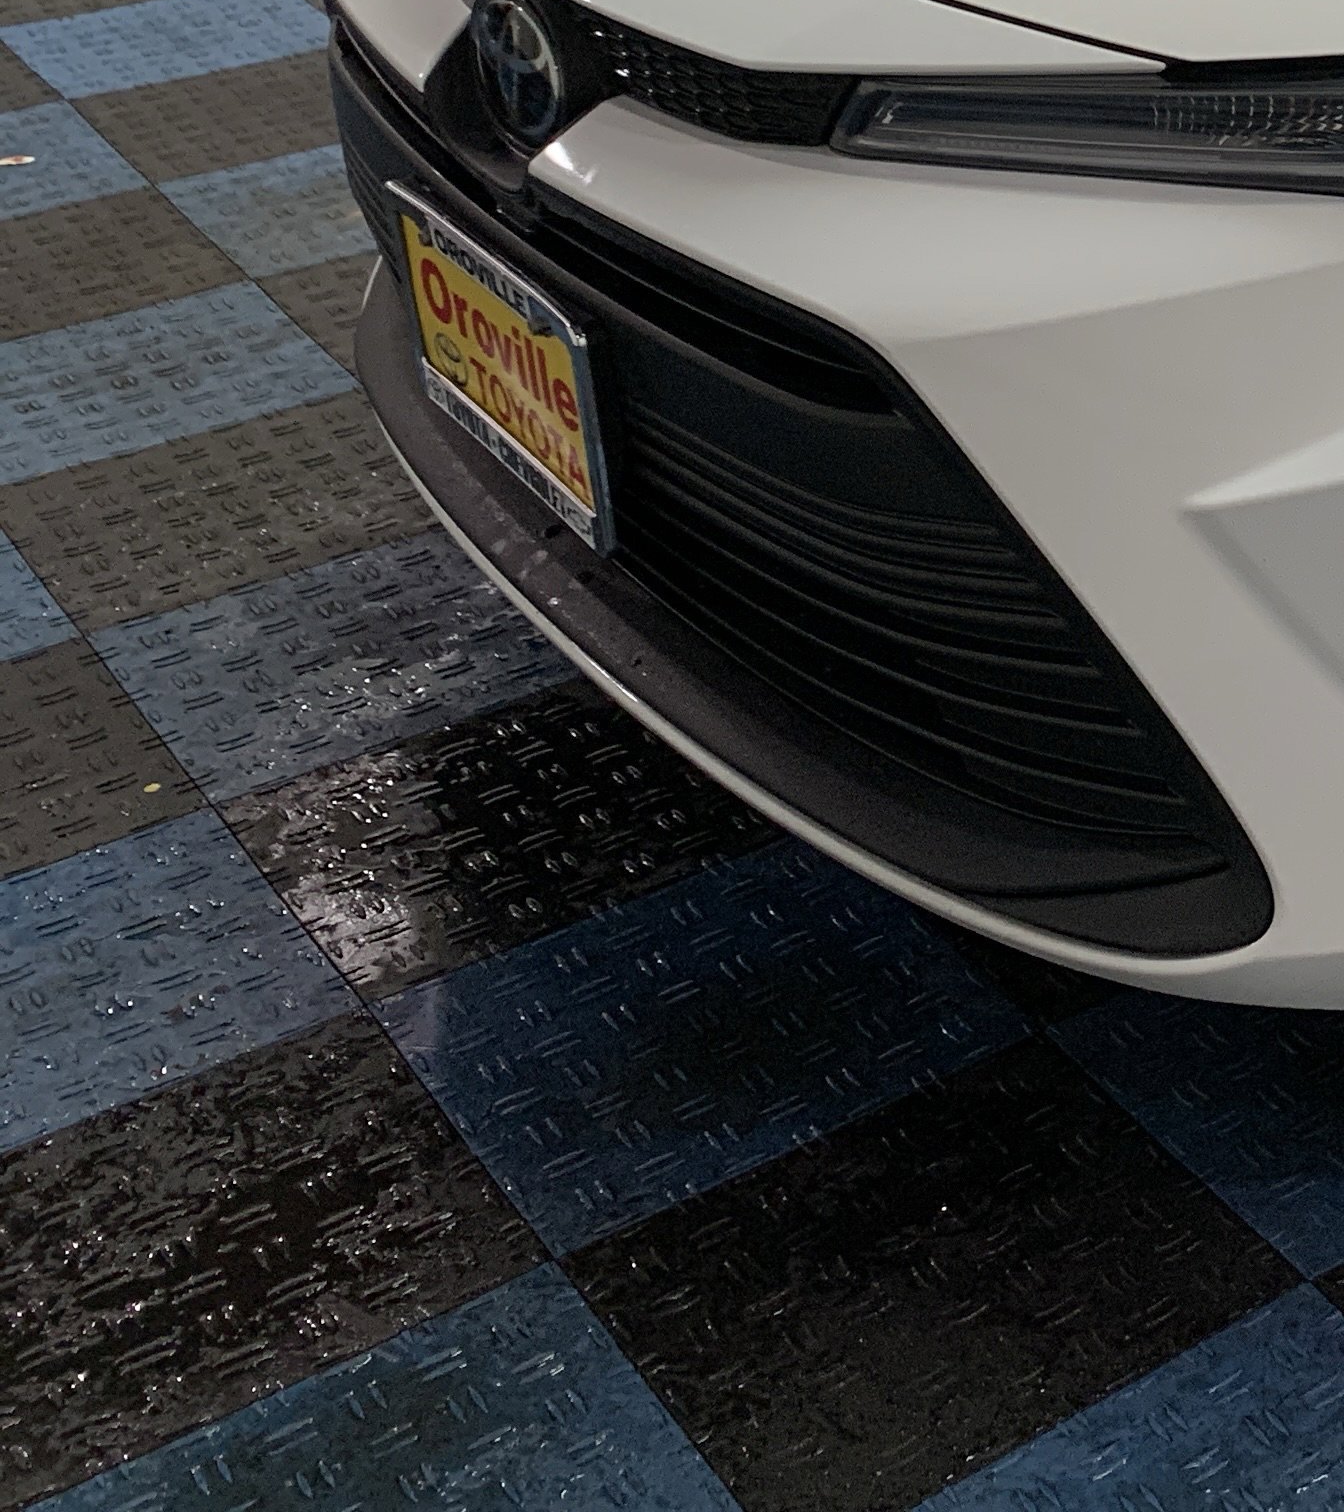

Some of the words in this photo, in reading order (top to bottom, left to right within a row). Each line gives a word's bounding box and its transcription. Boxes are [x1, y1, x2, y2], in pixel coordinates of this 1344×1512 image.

[433, 228, 529, 319] OROVILLE
[420, 257, 580, 433] Oroville
[469, 356, 590, 489] TOYOTA
